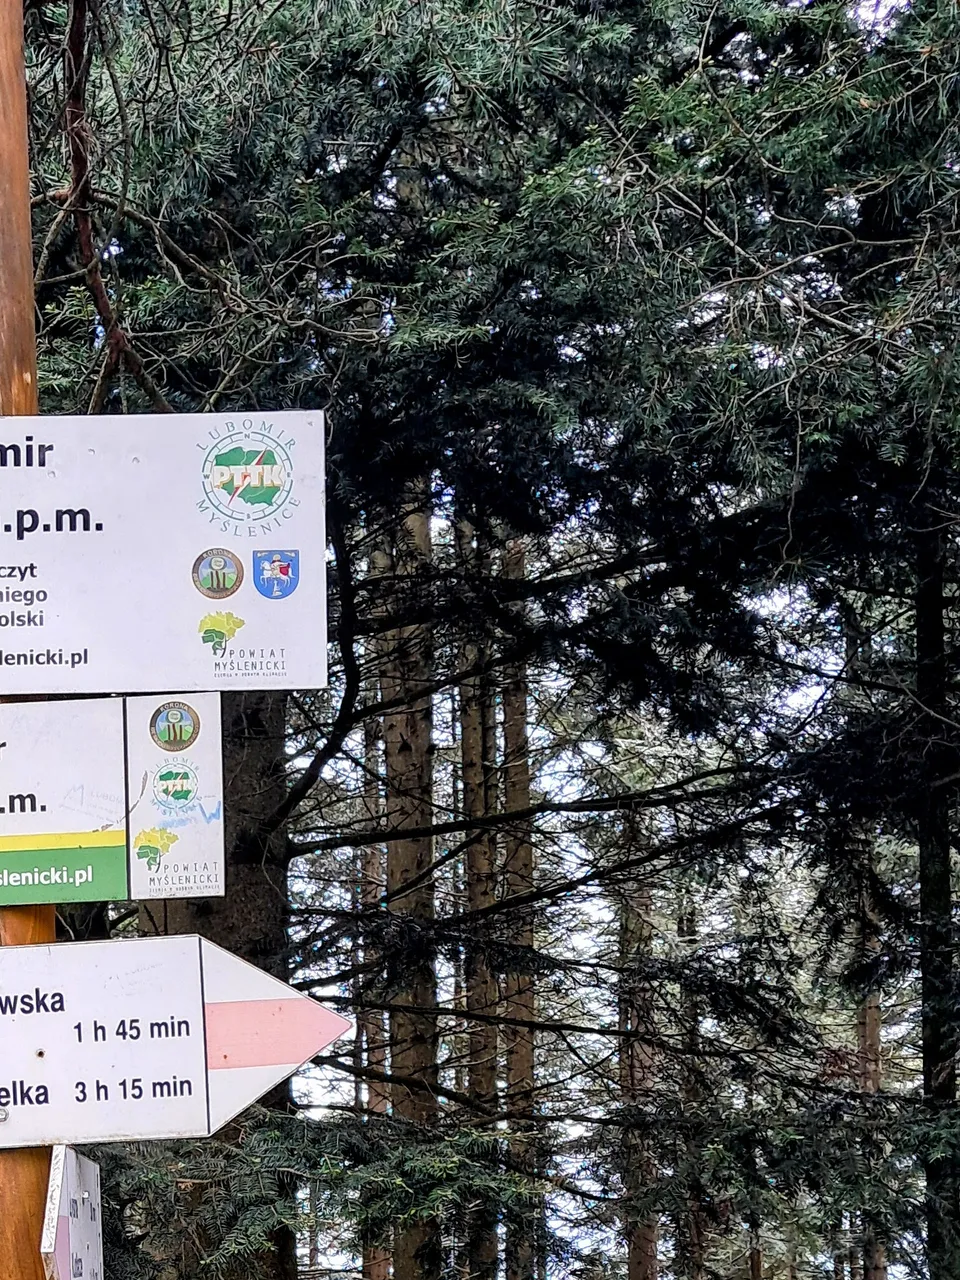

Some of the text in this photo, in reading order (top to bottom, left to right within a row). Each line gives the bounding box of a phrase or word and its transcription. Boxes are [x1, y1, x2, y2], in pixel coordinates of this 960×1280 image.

[196, 419, 296, 451] LUBOMIR
[213, 465, 283, 488] PTTK
[229, 648, 286, 659] POWIAT
[214, 659, 286, 672] MYŚLENICKI
[163, 861, 218, 874] POWIAT
[149, 874, 219, 887] MYŚLENICKI
[73, 1021, 83, 1043] 1
[93, 1020, 106, 1042] h
[115, 1018, 141, 1041] 45
[149, 1015, 190, 1039] min
[75, 1081, 87, 1103] 3
[96, 1079, 109, 1101] h
[118, 1078, 143, 1100] 15
[152, 1075, 193, 1098] min
